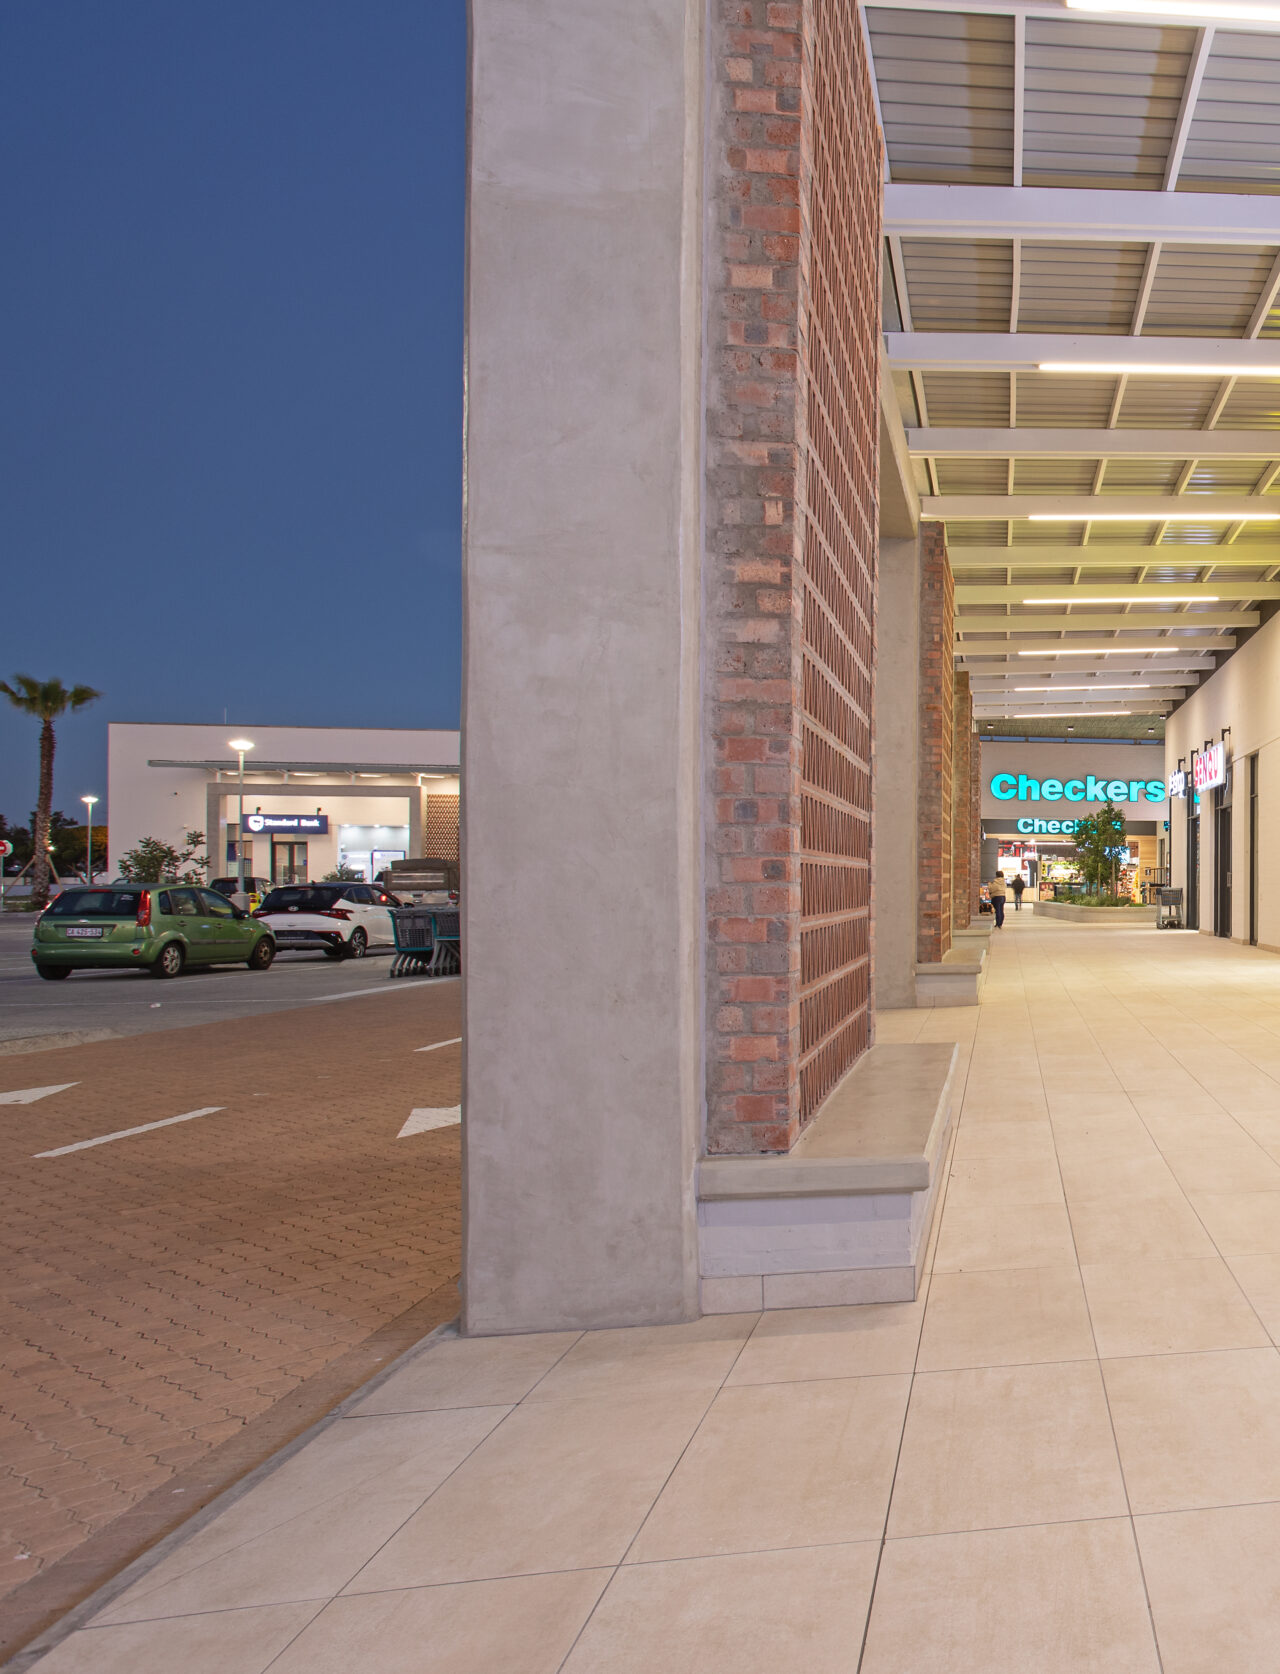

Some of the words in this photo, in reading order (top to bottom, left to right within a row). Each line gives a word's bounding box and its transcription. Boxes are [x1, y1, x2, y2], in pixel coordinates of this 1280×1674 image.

[990, 773, 1166, 803] Checkers
[264, 818, 298, 827] Standard
[301, 818, 320, 827] Bank
